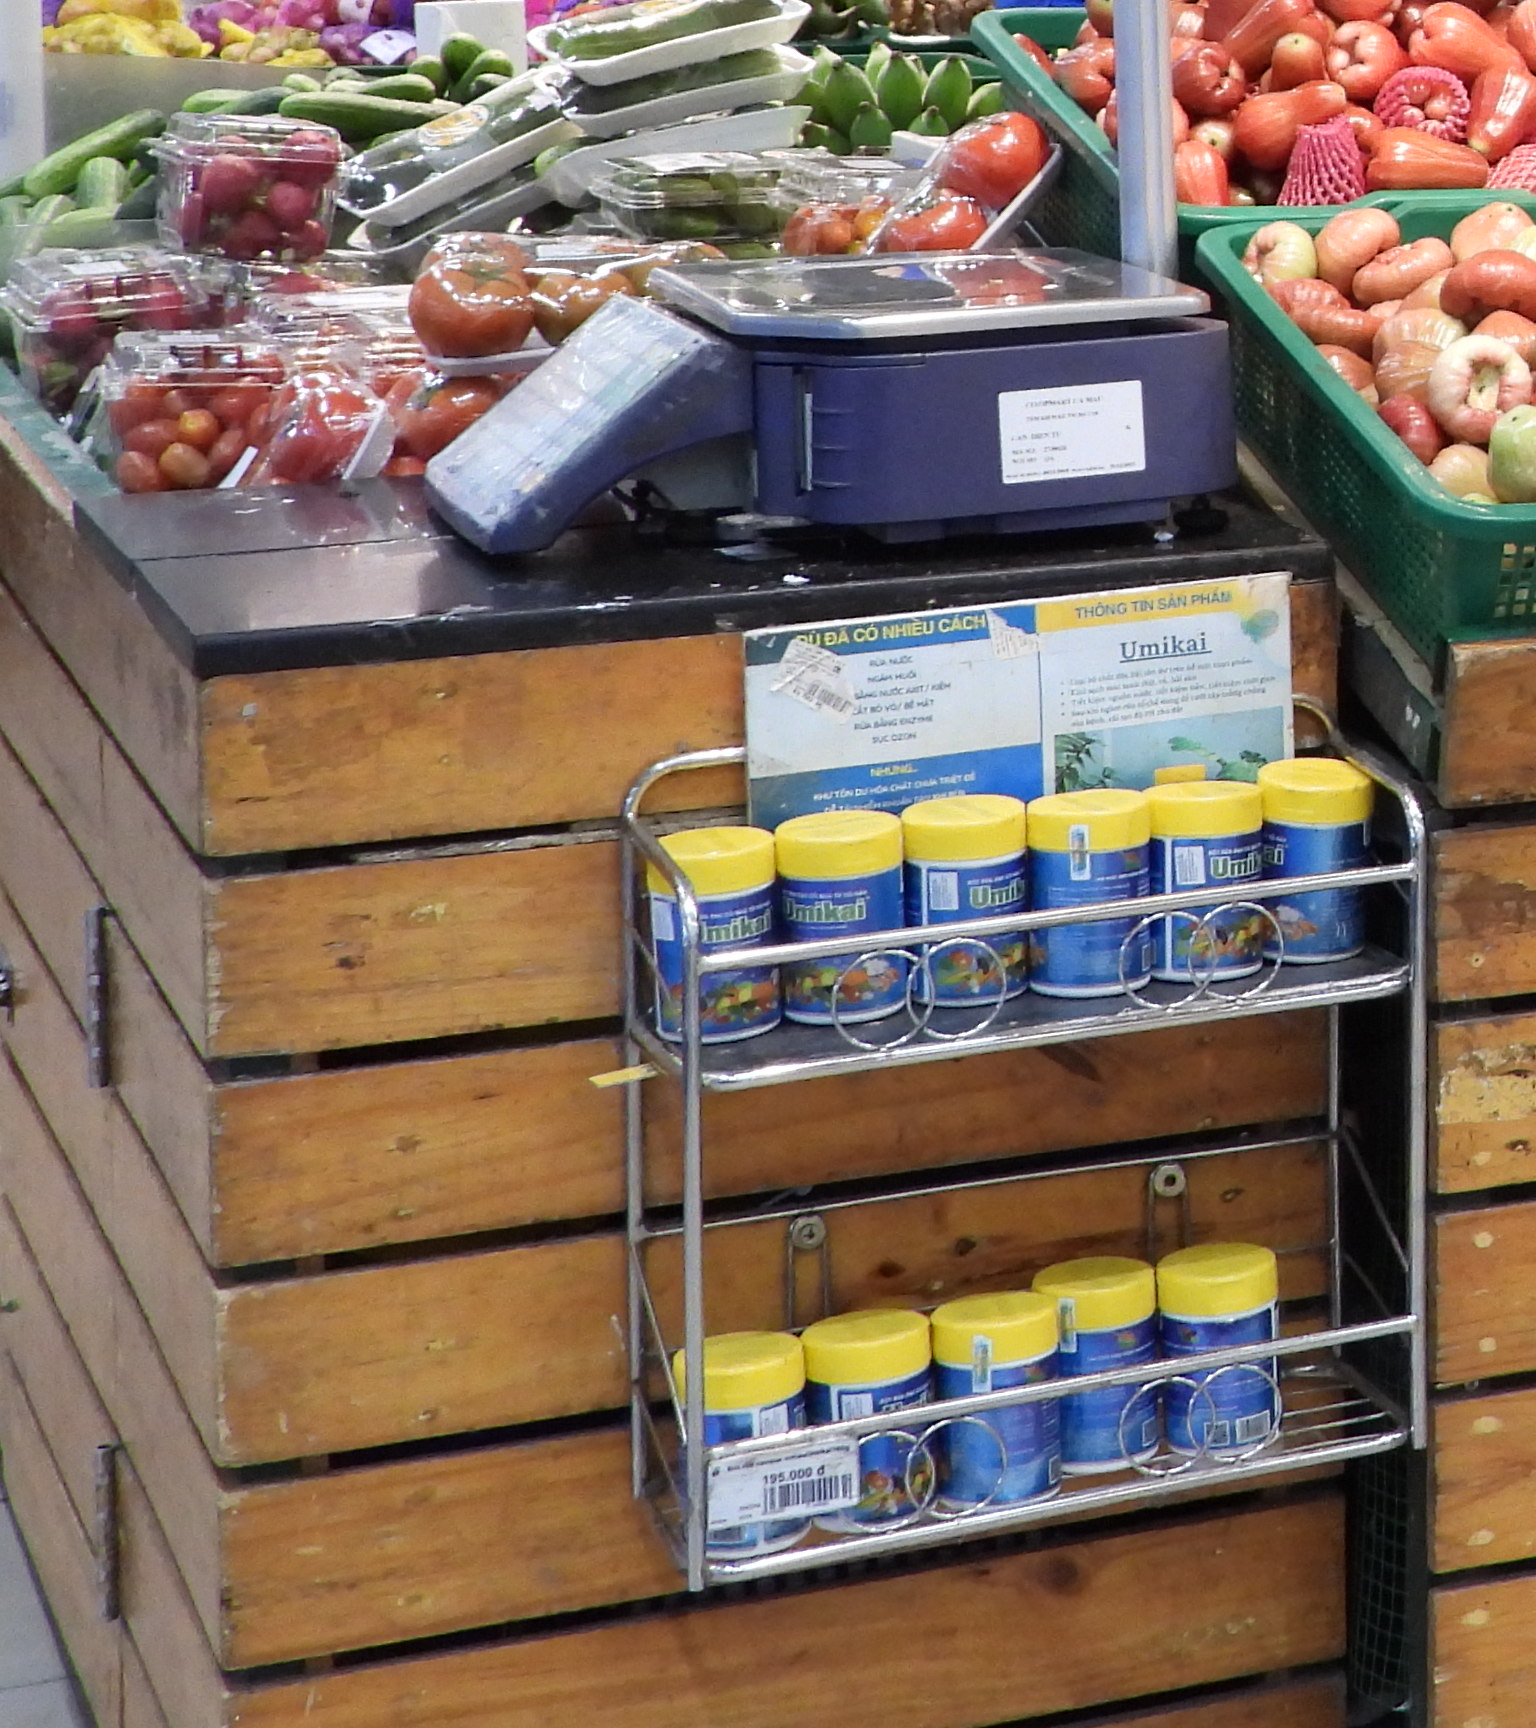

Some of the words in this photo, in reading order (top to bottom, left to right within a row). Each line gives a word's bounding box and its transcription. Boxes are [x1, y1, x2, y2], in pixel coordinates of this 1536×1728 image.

[1075, 602, 1127, 619] THÔNG
[1131, 599, 1154, 612] TIN
[854, 624, 878, 642] CÓ
[883, 618, 933, 639] NHIỀU
[938, 613, 987, 632] CÁCH
[1120, 632, 1212, 661] Umikai
[763, 1467, 813, 1485] 195.000
